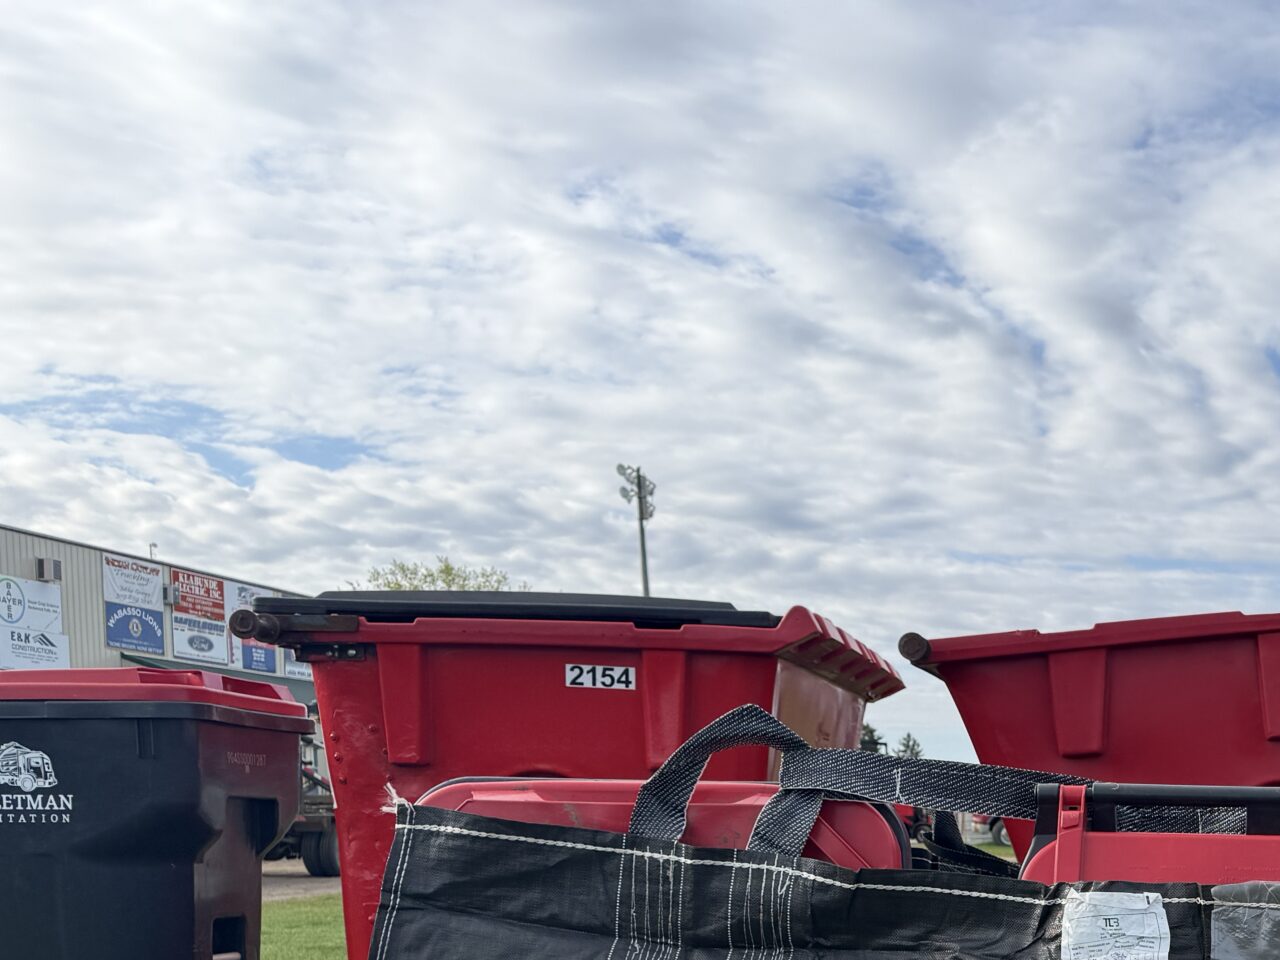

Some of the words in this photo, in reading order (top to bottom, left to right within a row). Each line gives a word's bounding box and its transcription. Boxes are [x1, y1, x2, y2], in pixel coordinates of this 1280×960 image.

[178, 572, 218, 590] KLABUNDE
[0, 596, 23, 607] AYER
[107, 607, 142, 628] WABASSO
[142, 611, 162, 638] LIONS
[10, 631, 31, 644] E&K
[11, 643, 54, 655] CONSTRUCTION
[569, 665, 632, 688] 2154
[0, 794, 74, 810] ETMAN
